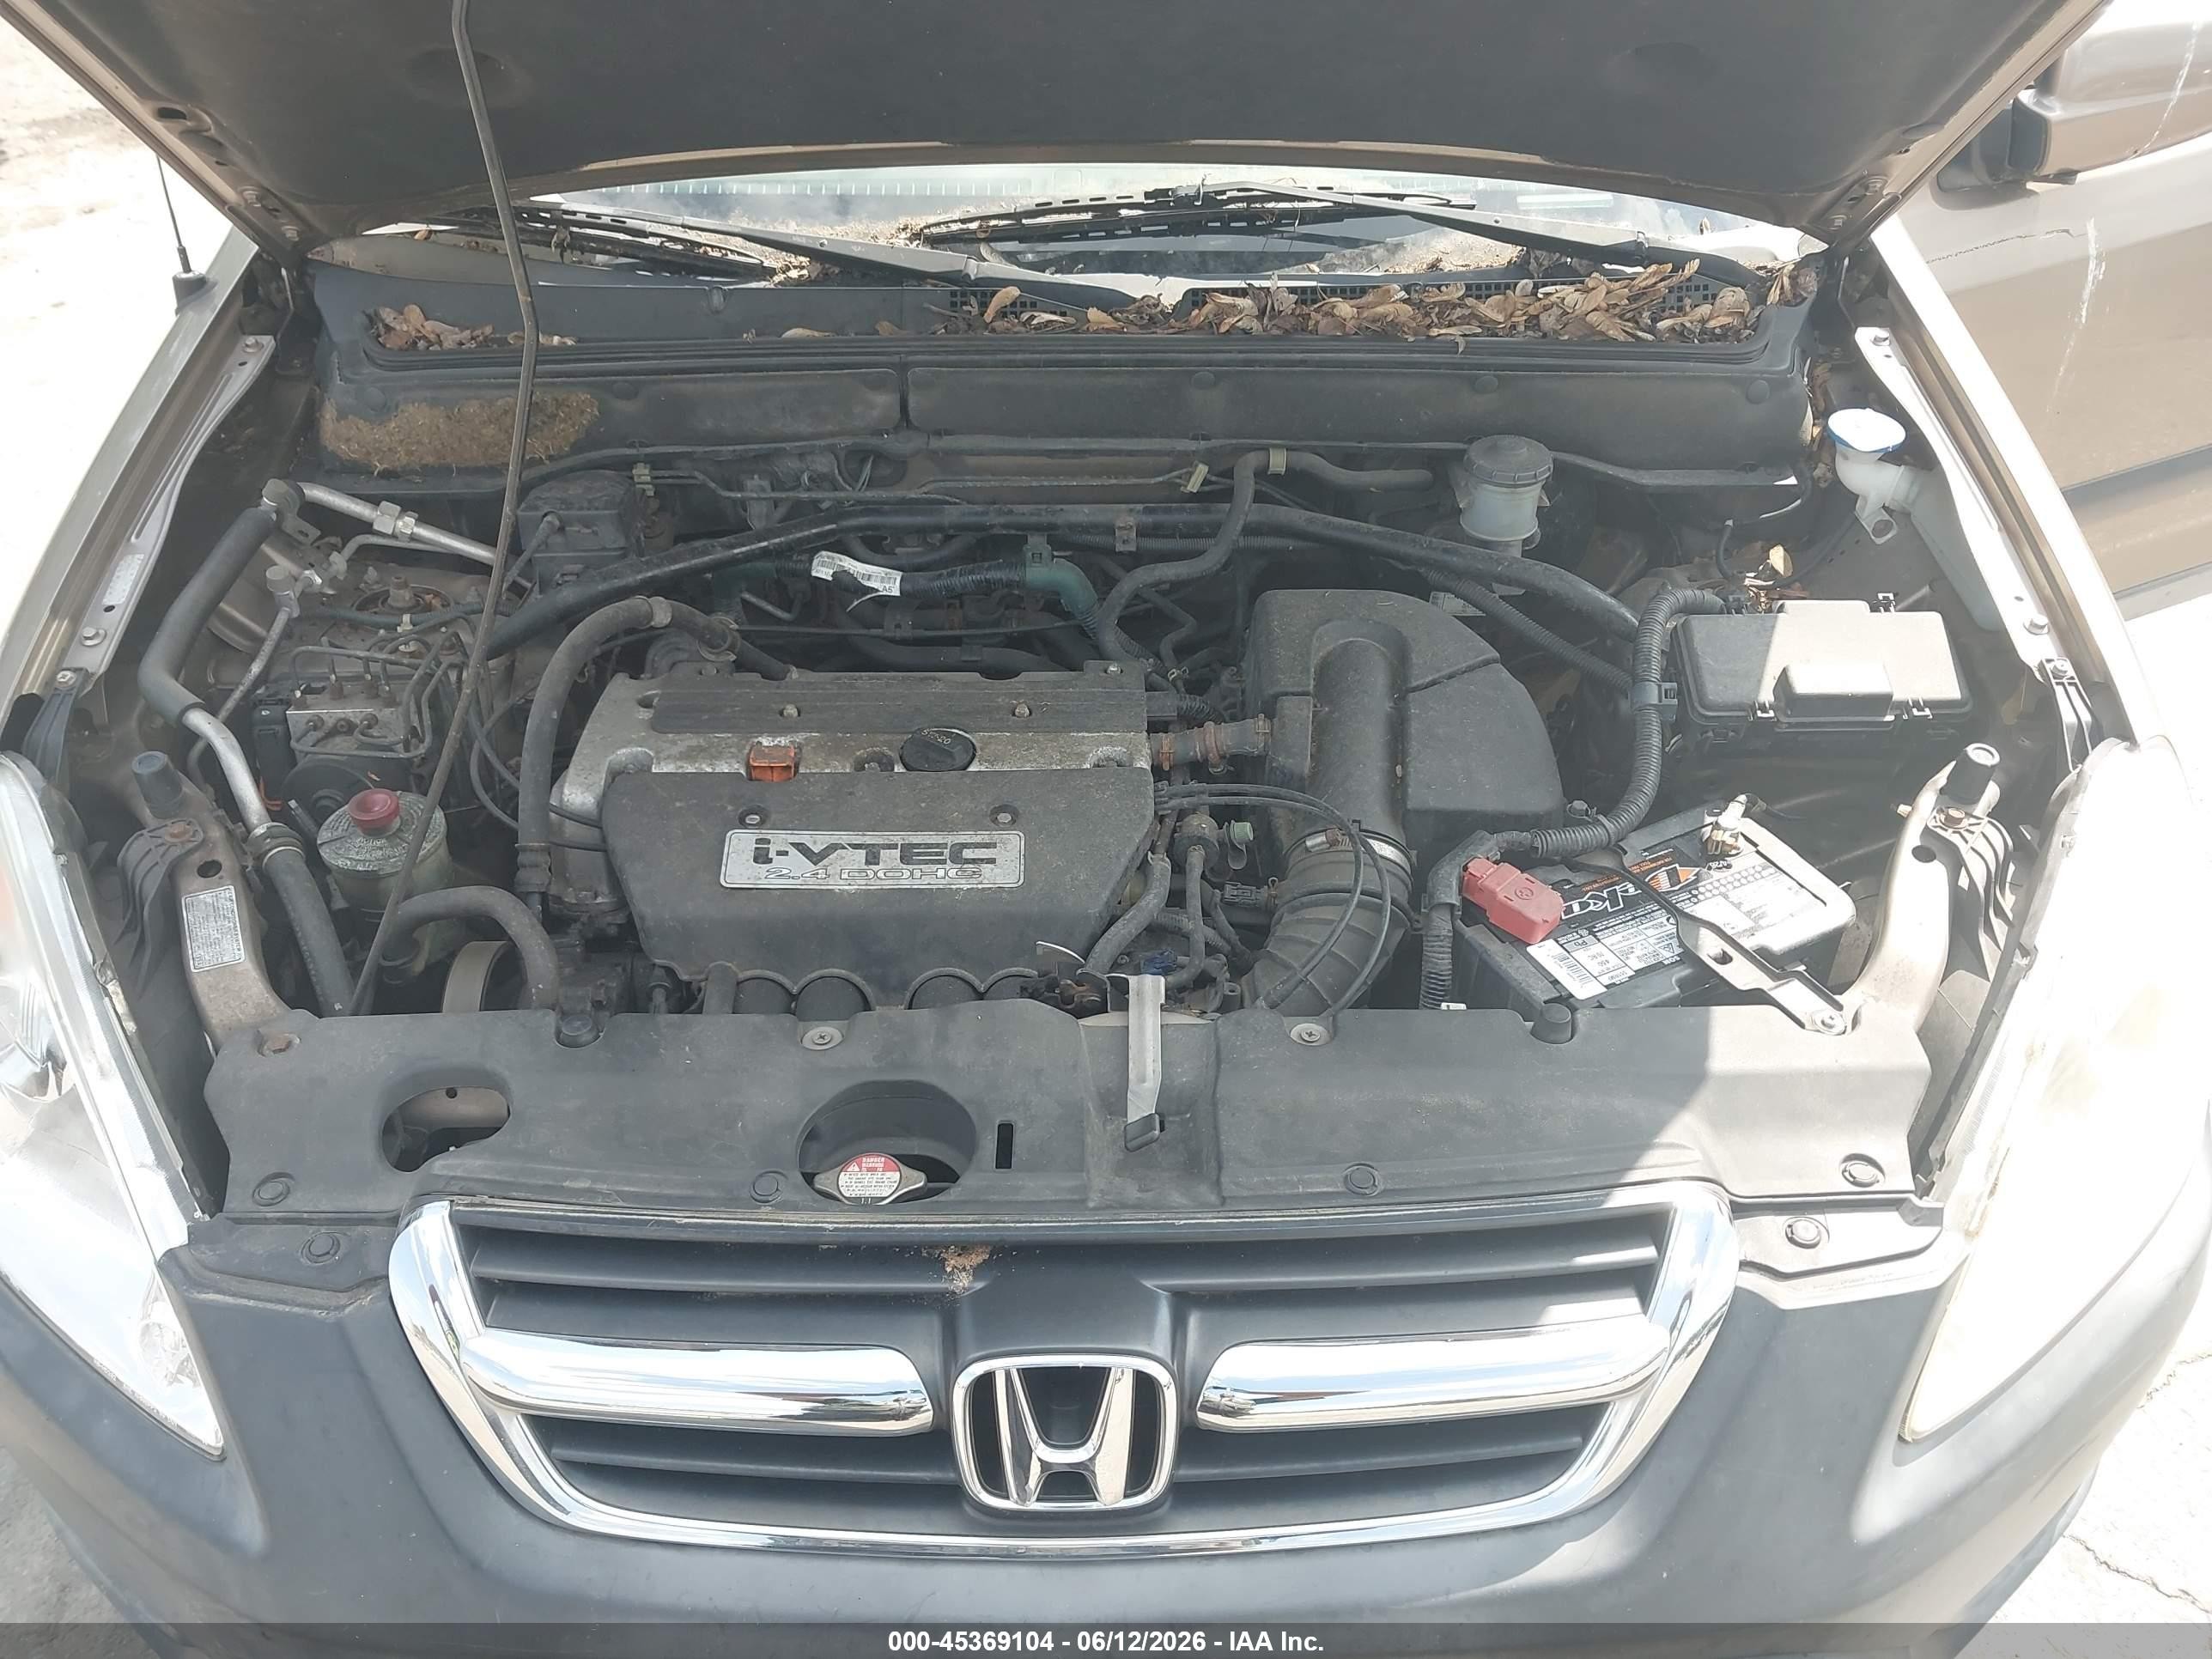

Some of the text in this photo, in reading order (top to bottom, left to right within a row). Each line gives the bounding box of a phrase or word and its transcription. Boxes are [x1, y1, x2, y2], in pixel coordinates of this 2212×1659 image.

[752, 837, 997, 866] i-VTEC
[765, 866, 982, 880] 2.4 DOHC
